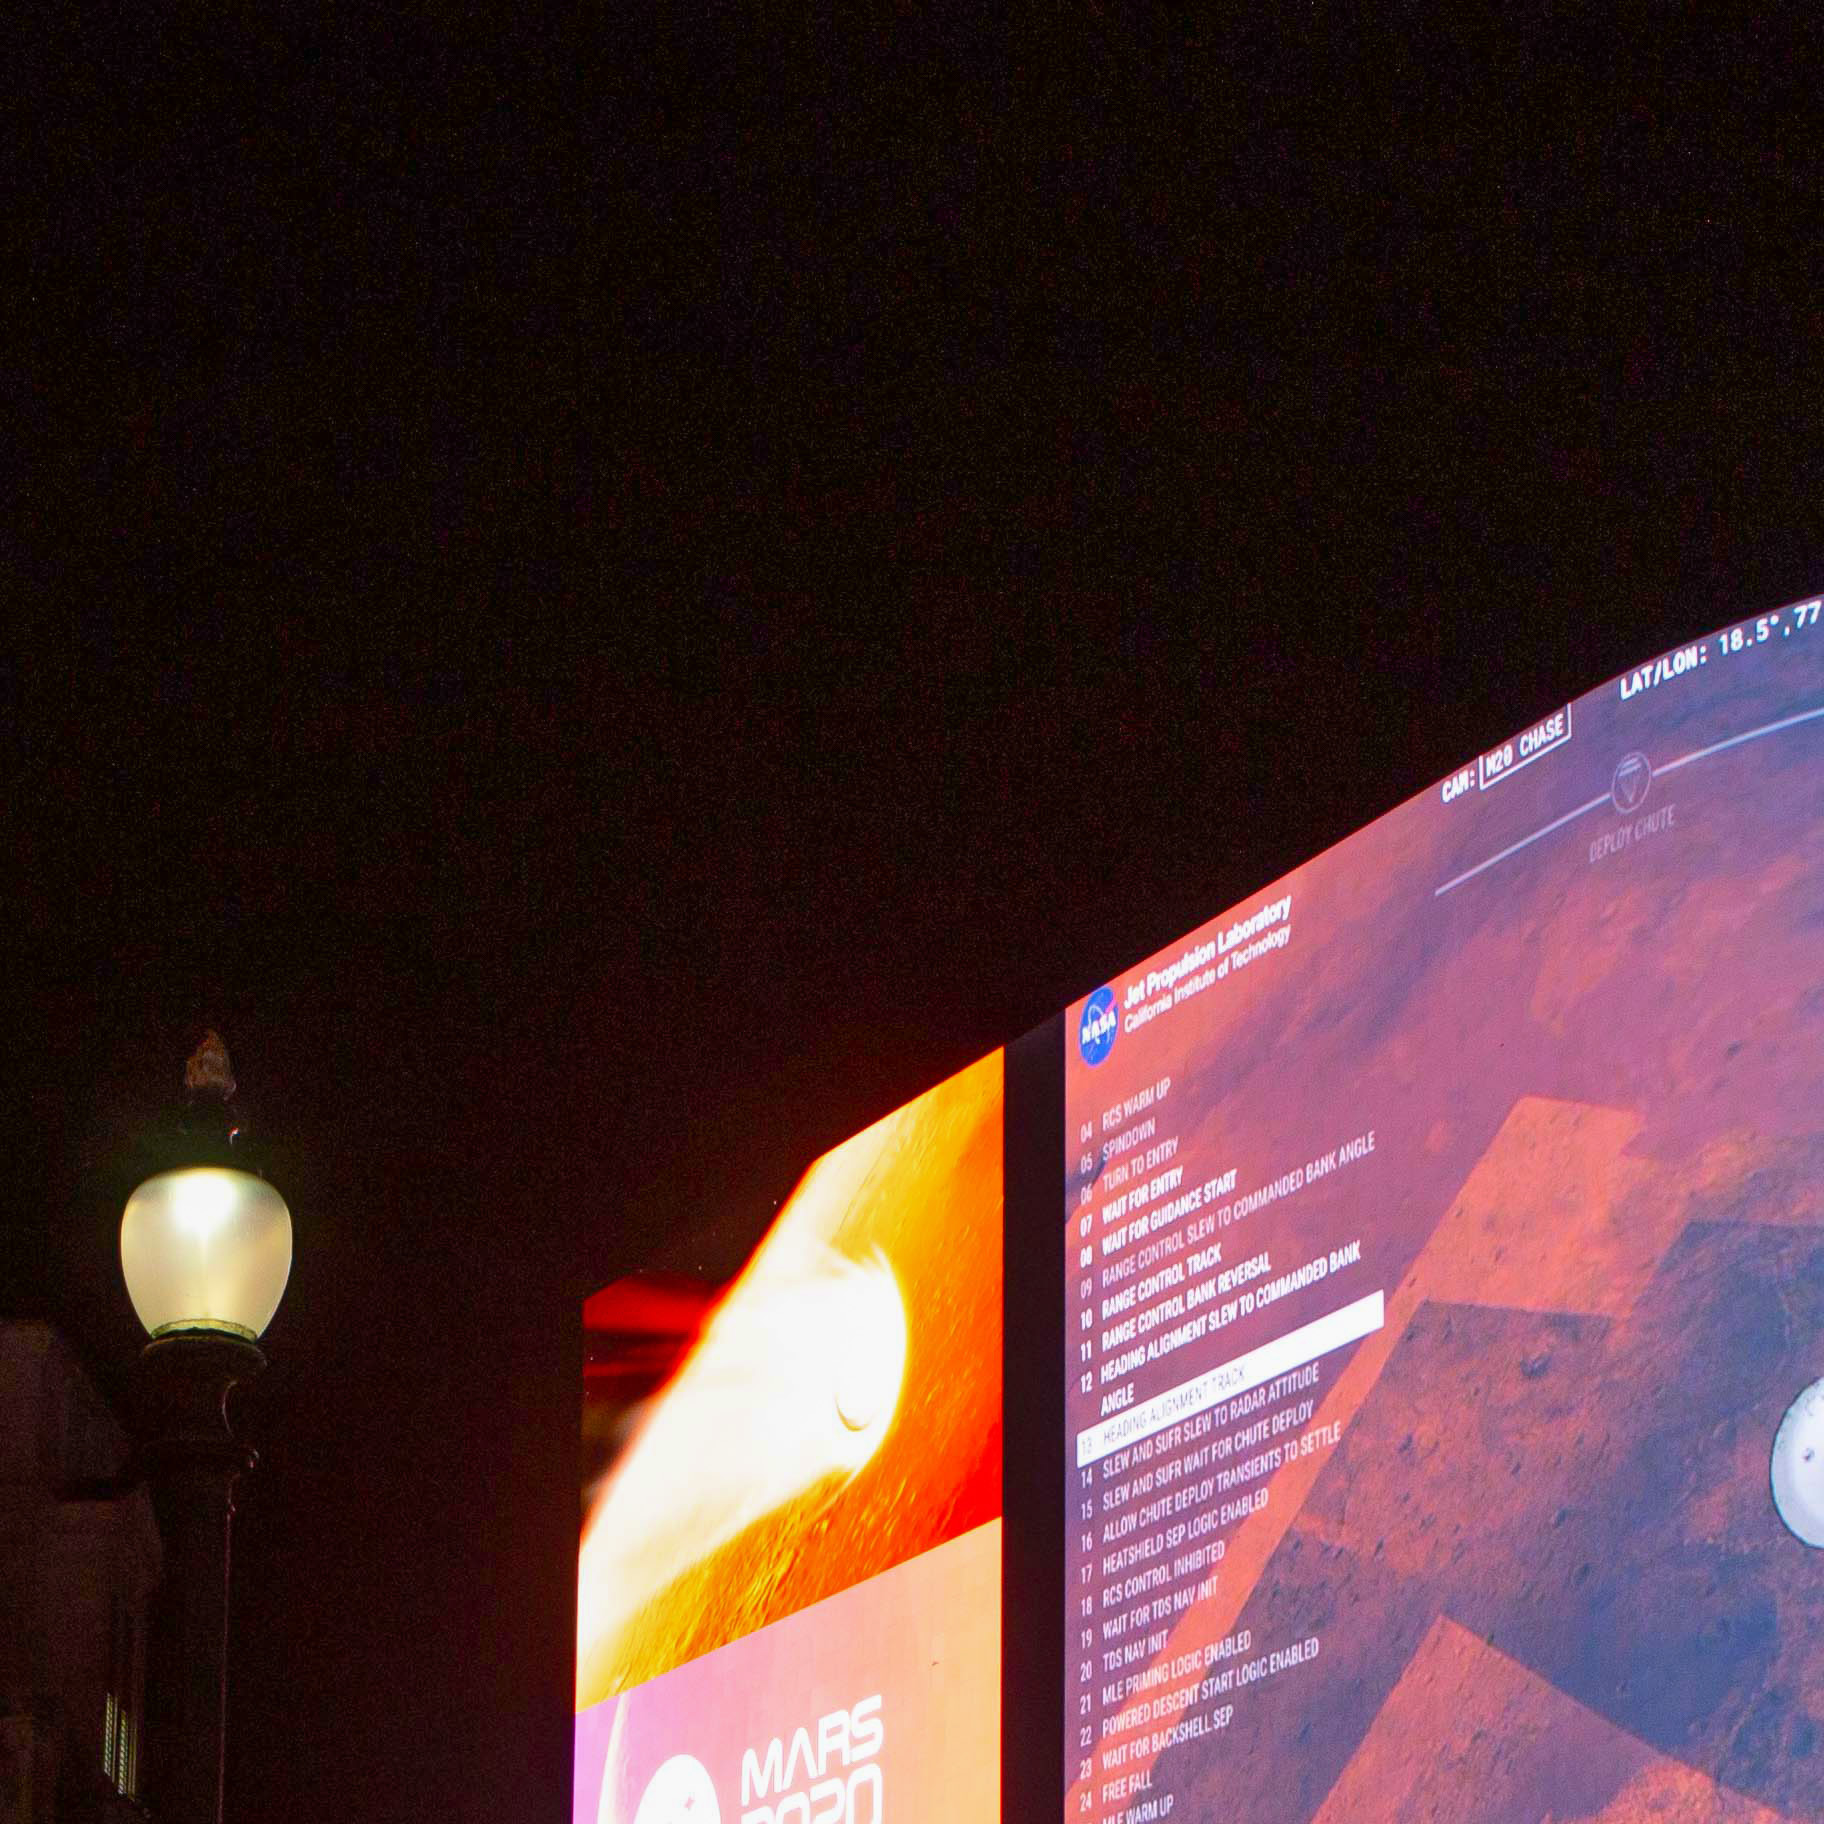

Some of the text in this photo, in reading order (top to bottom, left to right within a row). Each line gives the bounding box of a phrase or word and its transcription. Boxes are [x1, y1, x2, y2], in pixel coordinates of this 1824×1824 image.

[1440, 770, 1475, 803] CAM:
[1520, 713, 1564, 758] CHASE
[1620, 645, 1708, 700] LAT/LON:
[1634, 804, 1676, 836] CHUTE
[1124, 895, 1292, 1009] Jet Propulsion Laboratory
[1124, 924, 1291, 1033] California Institute of Technology
[1082, 1011, 1117, 1044] NASA
[1080, 1076, 1171, 1143] 04 RCS WARM UP
[1080, 1117, 1156, 1174] 05 SPINDOWN
[1080, 1165, 1184, 1238] 07 WAIT FOR ENTRY
[1080, 1243, 1222, 1331] 10 RANGE CONTROL TRACK
[1081, 1487, 1269, 1584] 17 HEATSHIELD SEP LOGIC ENABLED
[1080, 1637, 1319, 1747] 22 POWERED DESCENT START LOGIC ENABLED
[741, 1694, 883, 1805] MARS
[1080, 1768, 1153, 1811] 24 FREE FALL
